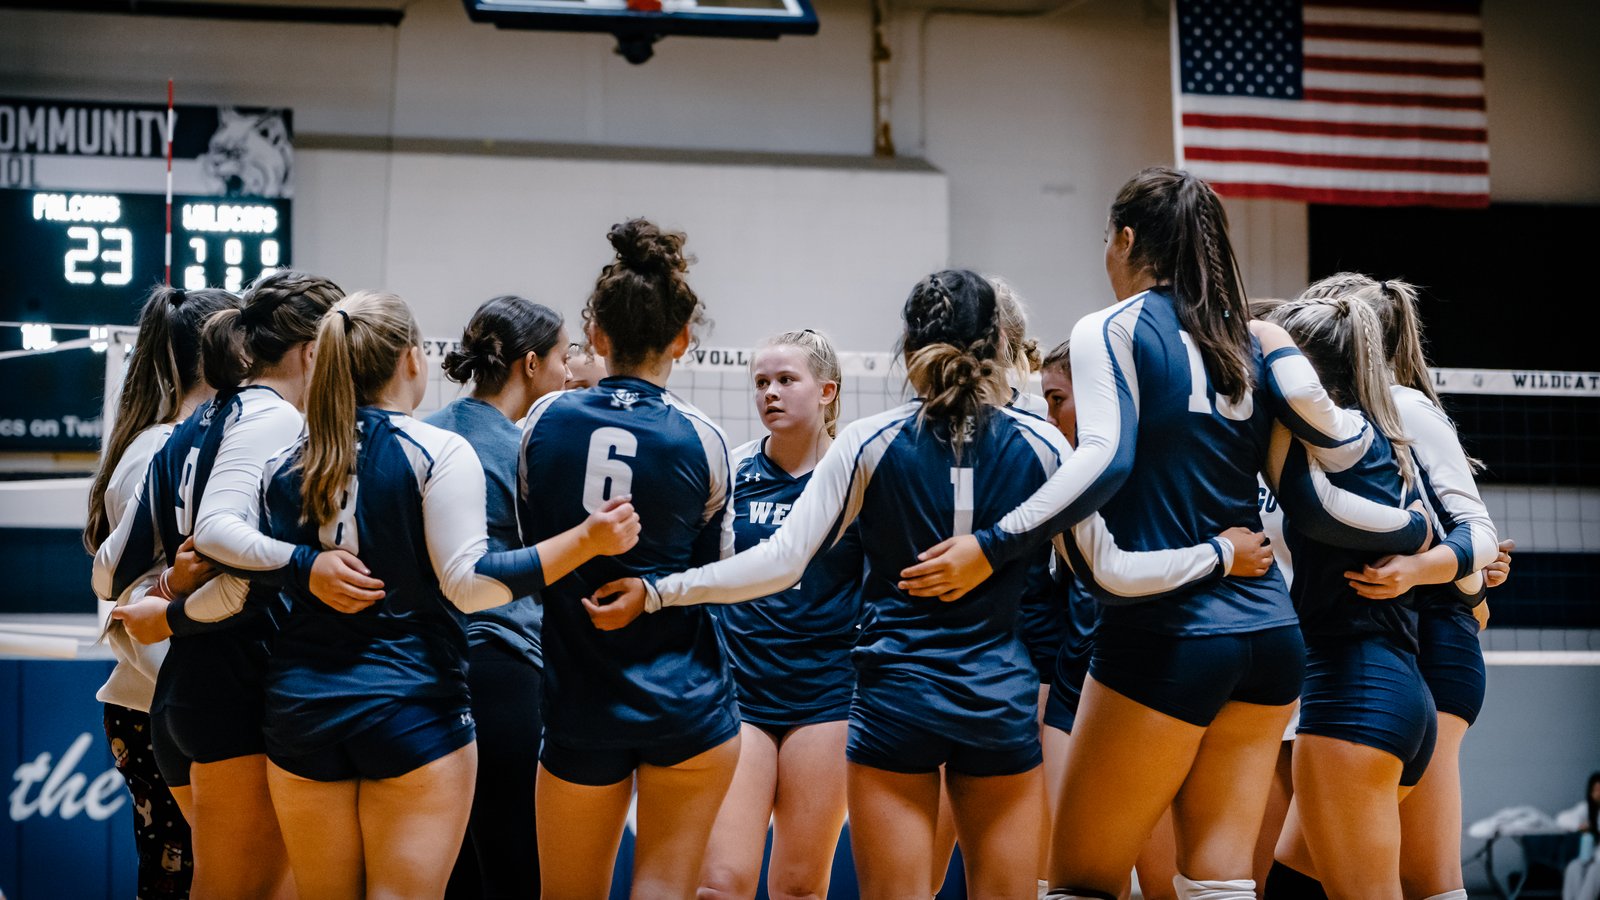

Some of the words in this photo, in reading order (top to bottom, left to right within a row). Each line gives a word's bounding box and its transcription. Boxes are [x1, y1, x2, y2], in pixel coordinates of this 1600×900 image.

[64, 226, 133, 285] 23
[224, 238, 243, 265] 0
[260, 239, 279, 266] 0
[29, 418, 60, 437] on
[582, 426, 638, 516] 6
[949, 466, 974, 537] 1
[9, 732, 127, 822] the
